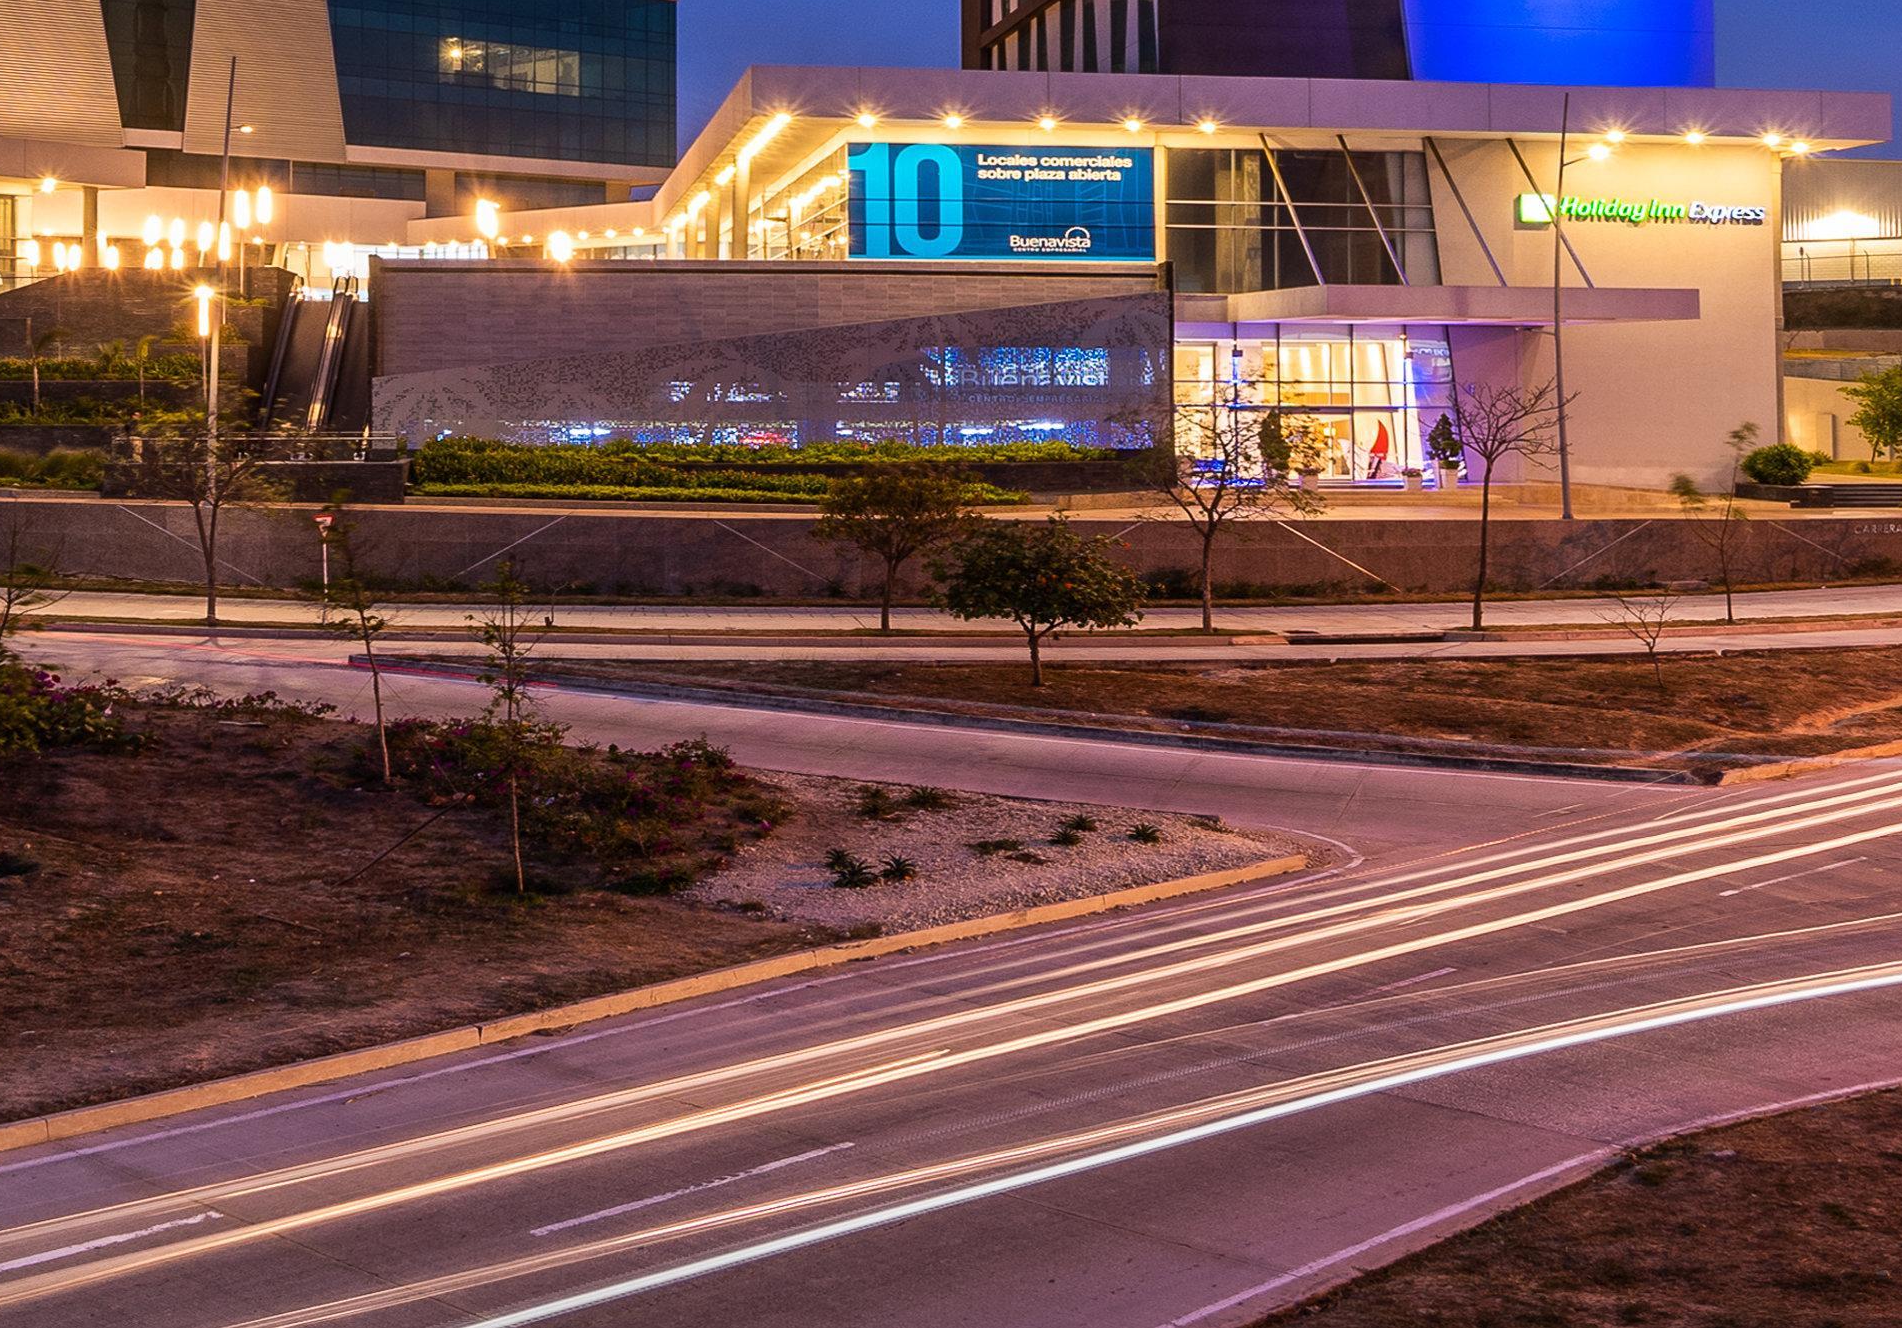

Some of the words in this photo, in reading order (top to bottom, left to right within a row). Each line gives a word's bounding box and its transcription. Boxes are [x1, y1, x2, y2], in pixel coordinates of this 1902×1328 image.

[977, 153, 1038, 168] Locales
[1040, 154, 1133, 169] comerciales
[977, 168, 1023, 181] sobre
[1024, 168, 1066, 182] plaza
[1068, 168, 1122, 182] abierta
[848, 143, 963, 257] 10
[1559, 196, 1648, 222] Holiday
[1649, 198, 1686, 219] Inn
[1688, 200, 1766, 223] Express
[1010, 234, 1091, 248] Buenavista
[968, 393, 1018, 404] CENTRO
